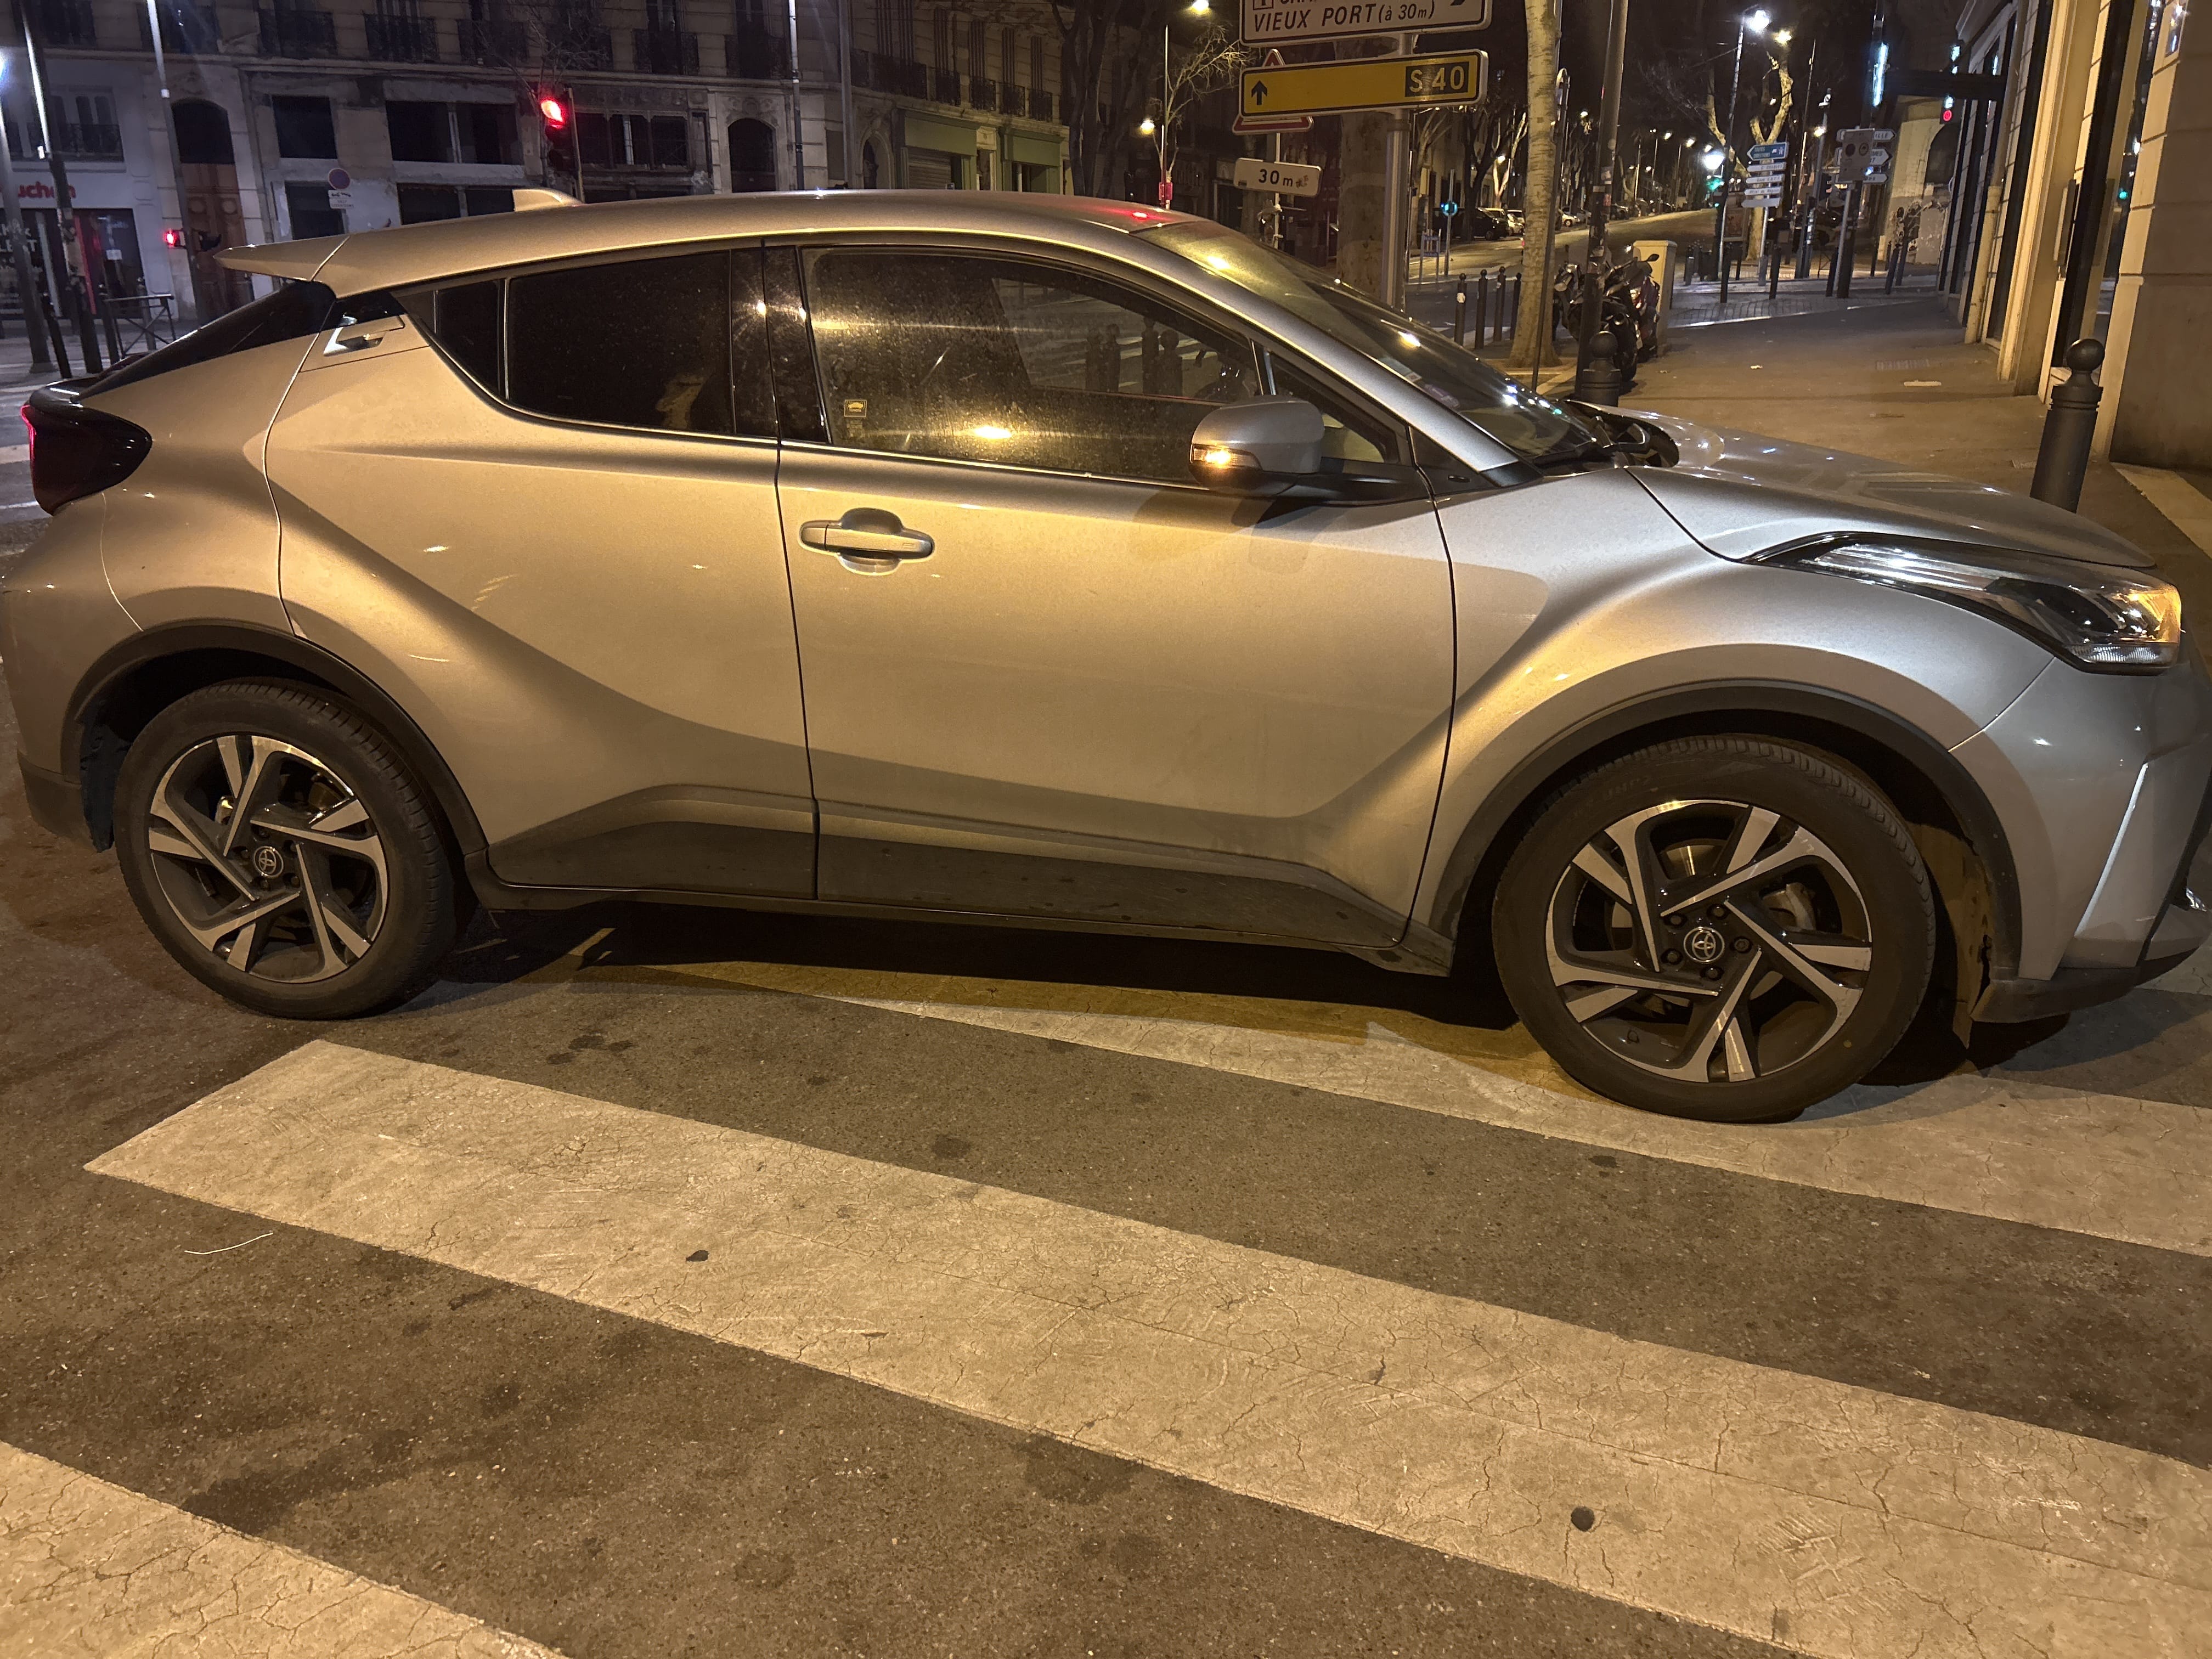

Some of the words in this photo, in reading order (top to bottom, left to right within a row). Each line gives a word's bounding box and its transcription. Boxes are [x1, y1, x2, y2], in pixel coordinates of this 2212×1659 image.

[1254, 9, 1311, 32] VIEUX
[1322, 3, 1376, 26] PORT
[1378, 4, 1392, 23] (à
